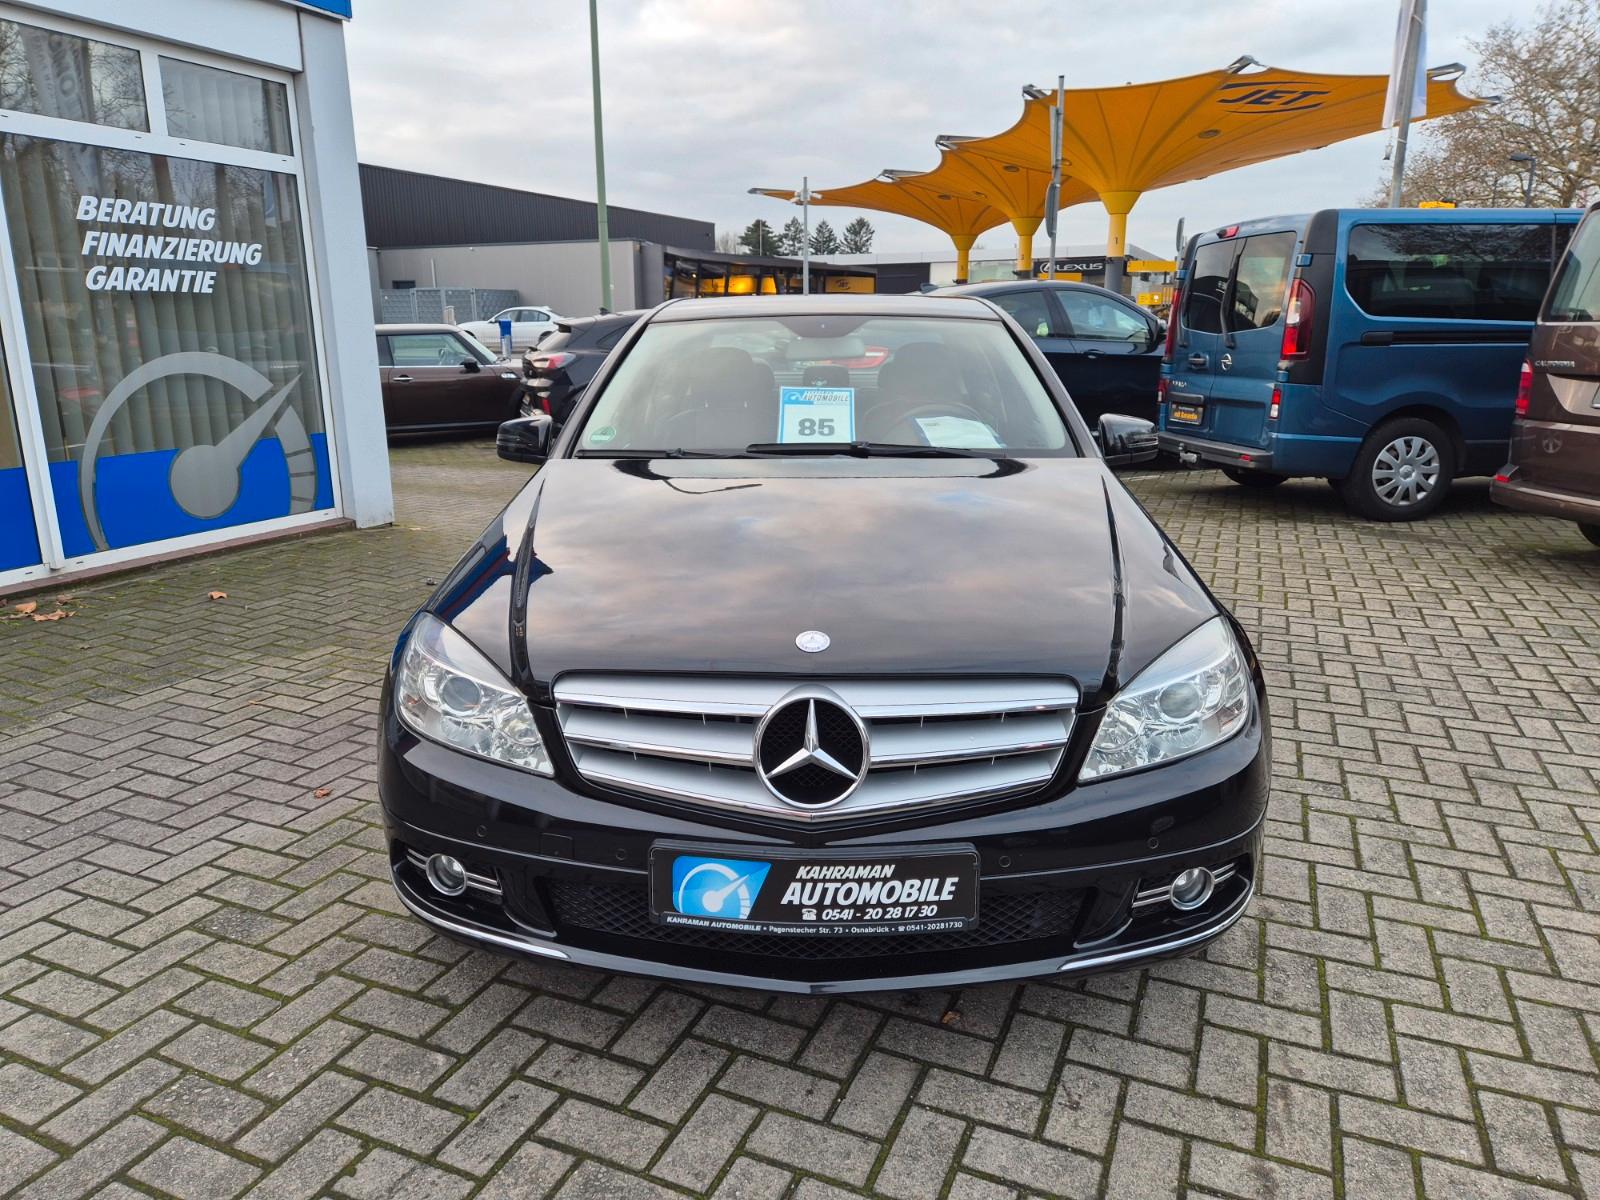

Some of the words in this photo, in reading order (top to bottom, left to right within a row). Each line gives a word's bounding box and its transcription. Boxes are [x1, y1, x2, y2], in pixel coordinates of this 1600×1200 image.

[1216, 89, 1331, 106] JET
[76, 195, 216, 231] BERATUNG
[81, 230, 263, 266] FINANZIERUNG
[1056, 262, 1104, 271] LEXUS
[85, 265, 217, 294] GARANTIE
[798, 417, 836, 437] 85
[795, 864, 896, 880] KAHRAMAN
[780, 877, 960, 906] AUTOMOBILE
[821, 908, 855, 921] 0541
[863, 907, 883, 920] 20
[884, 906, 902, 919] 28
[904, 906, 916, 918] 17
[918, 905, 938, 917] 30
[666, 916, 710, 927] KAHRAMAN
[711, 921, 762, 932] AUTOMOBILE
[769, 925, 817, 935] Pagenstecher
[851, 926, 890, 934] Osnabrück
[906, 921, 963, 932] 0541-20281730
